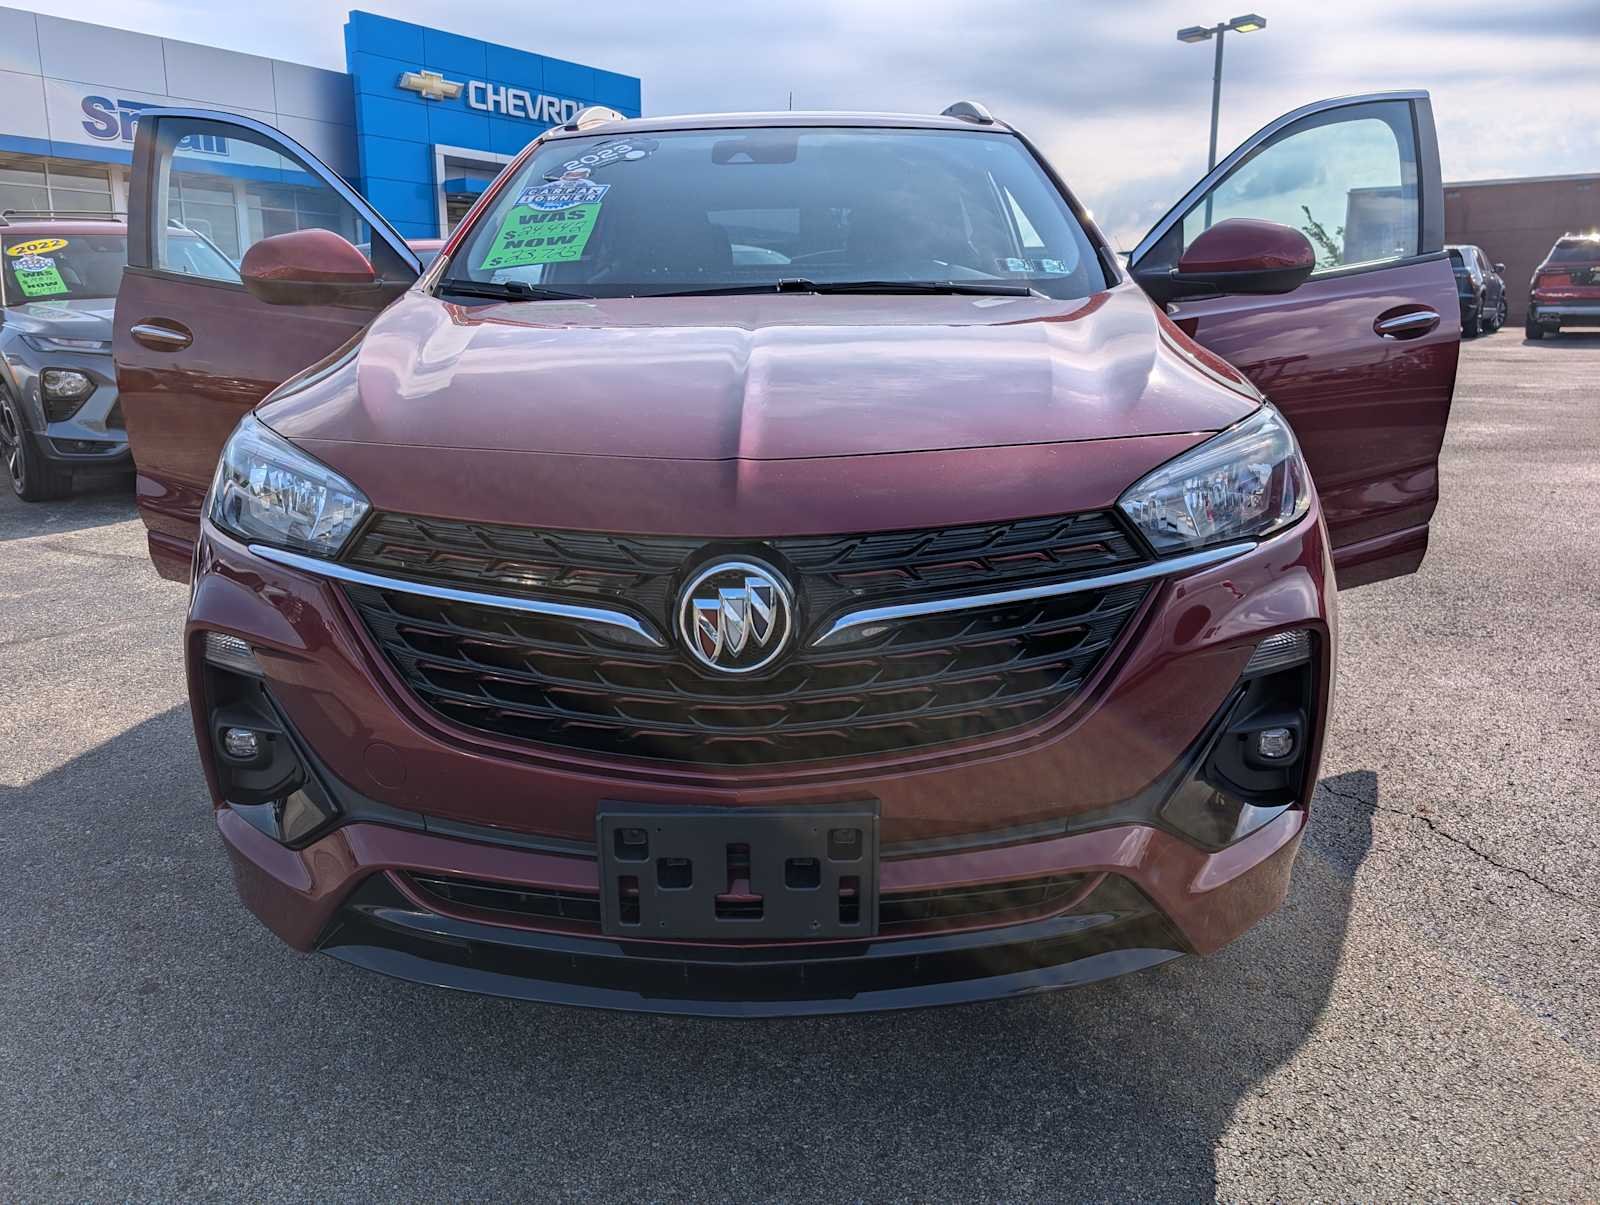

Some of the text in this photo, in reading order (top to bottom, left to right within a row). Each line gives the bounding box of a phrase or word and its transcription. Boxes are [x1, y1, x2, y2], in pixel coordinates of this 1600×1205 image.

[563, 145, 632, 170] 2023
[519, 210, 586, 224] WAS
[16, 240, 61, 254] 2022
[504, 235, 578, 249] NOW
[22, 270, 53, 278] WAS
[27, 281, 58, 289] NOW
